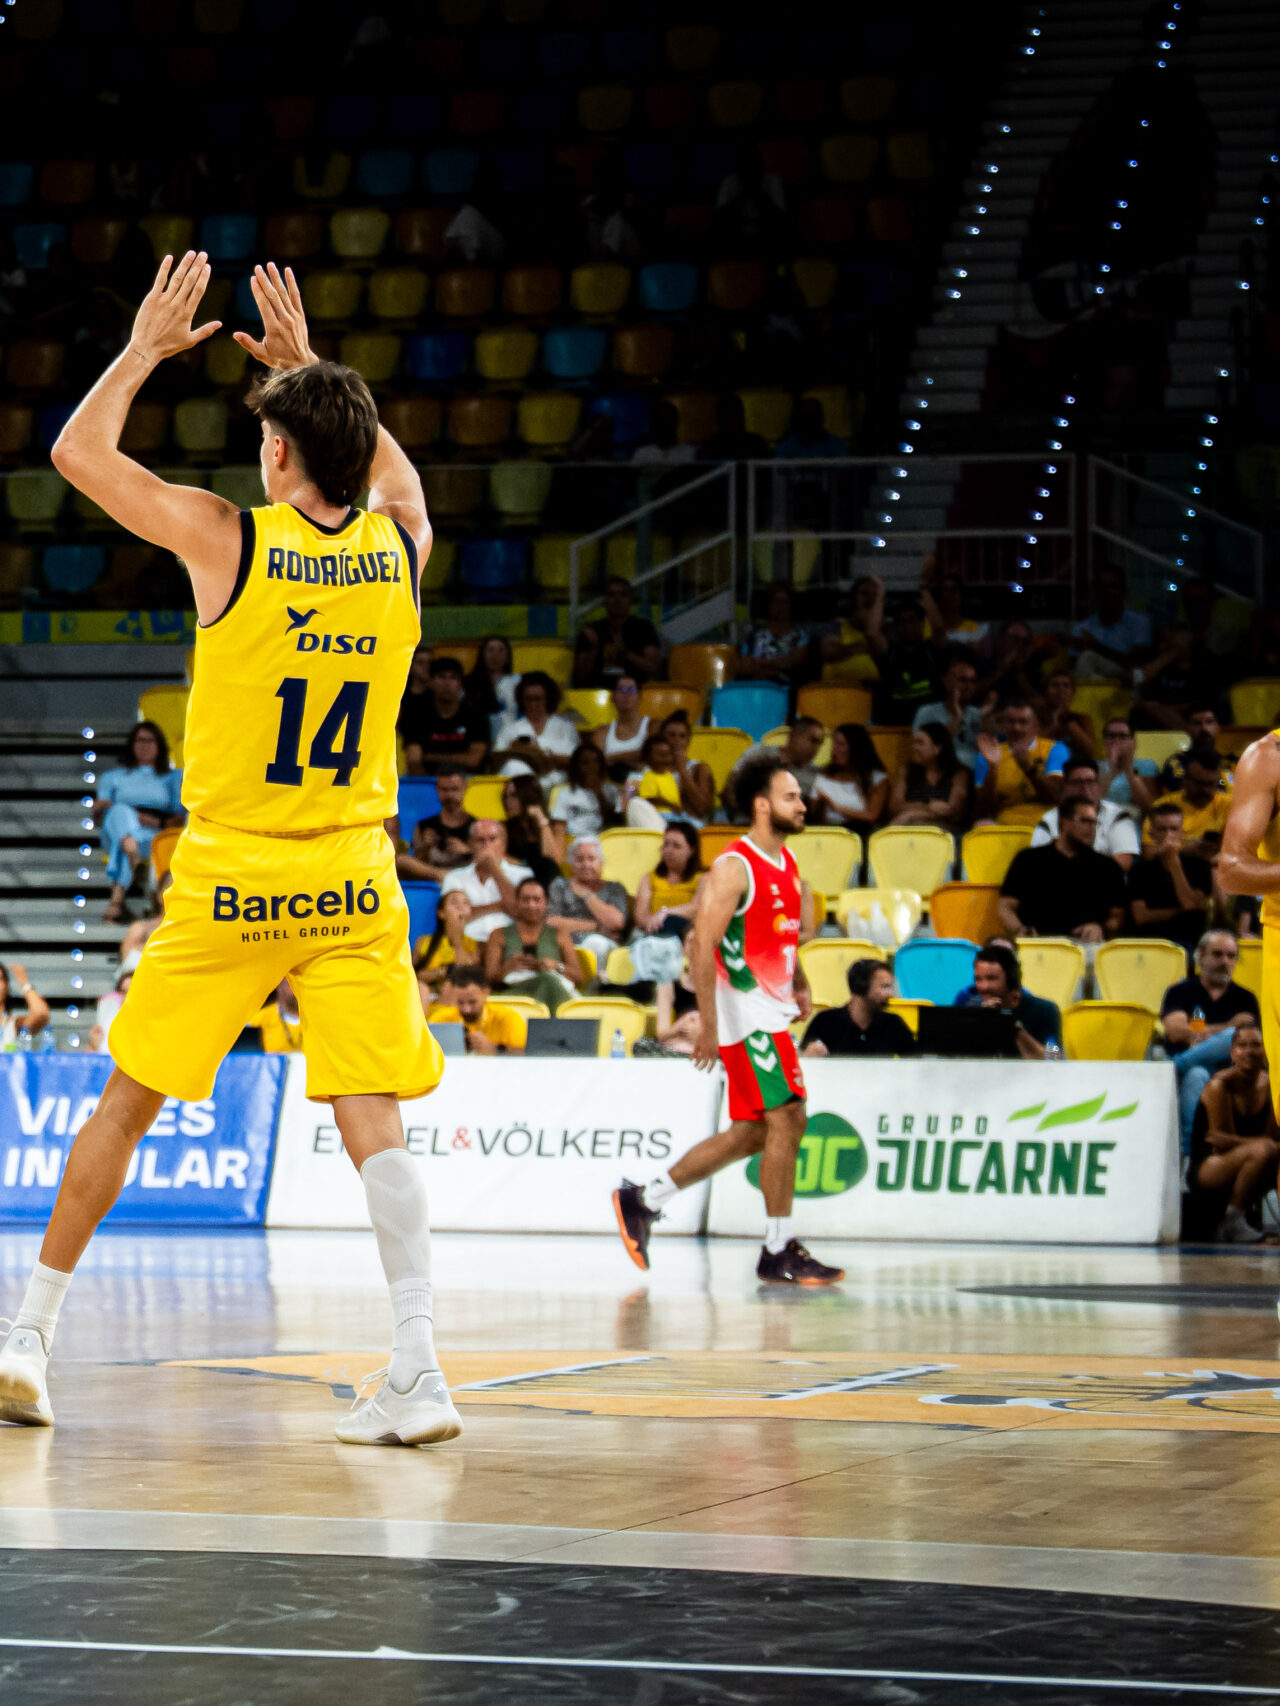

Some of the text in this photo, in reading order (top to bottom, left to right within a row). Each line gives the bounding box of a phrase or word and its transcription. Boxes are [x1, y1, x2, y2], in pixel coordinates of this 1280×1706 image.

[267, 547, 401, 587] RODRÍGUEZ
[265, 677, 370, 786] 14
[213, 879, 380, 922] Barceló
[242, 926, 351, 943] HOTEL GROUP
[877, 1113, 988, 1136] GRUPO
[875, 1139, 1117, 1196] JUCARNE
